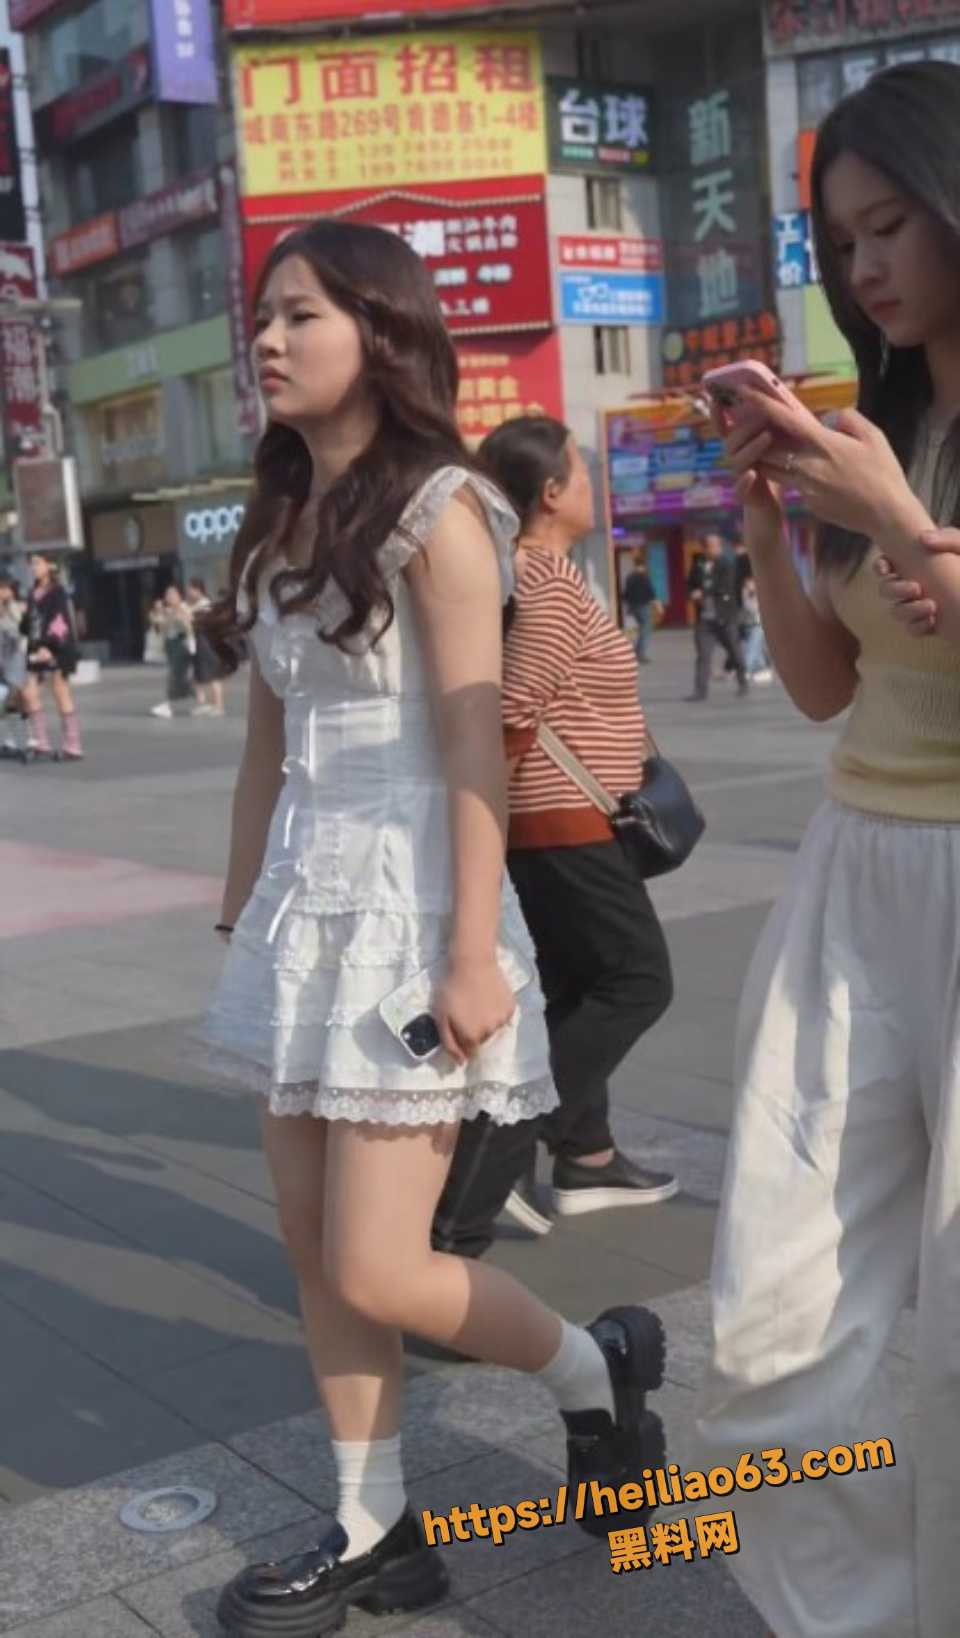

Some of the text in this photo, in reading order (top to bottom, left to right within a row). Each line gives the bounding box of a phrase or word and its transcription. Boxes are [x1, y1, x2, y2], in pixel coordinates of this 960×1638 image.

[241, 44, 534, 108] 门面招租
[559, 88, 648, 147] 台球
[689, 91, 738, 318] 新天地
